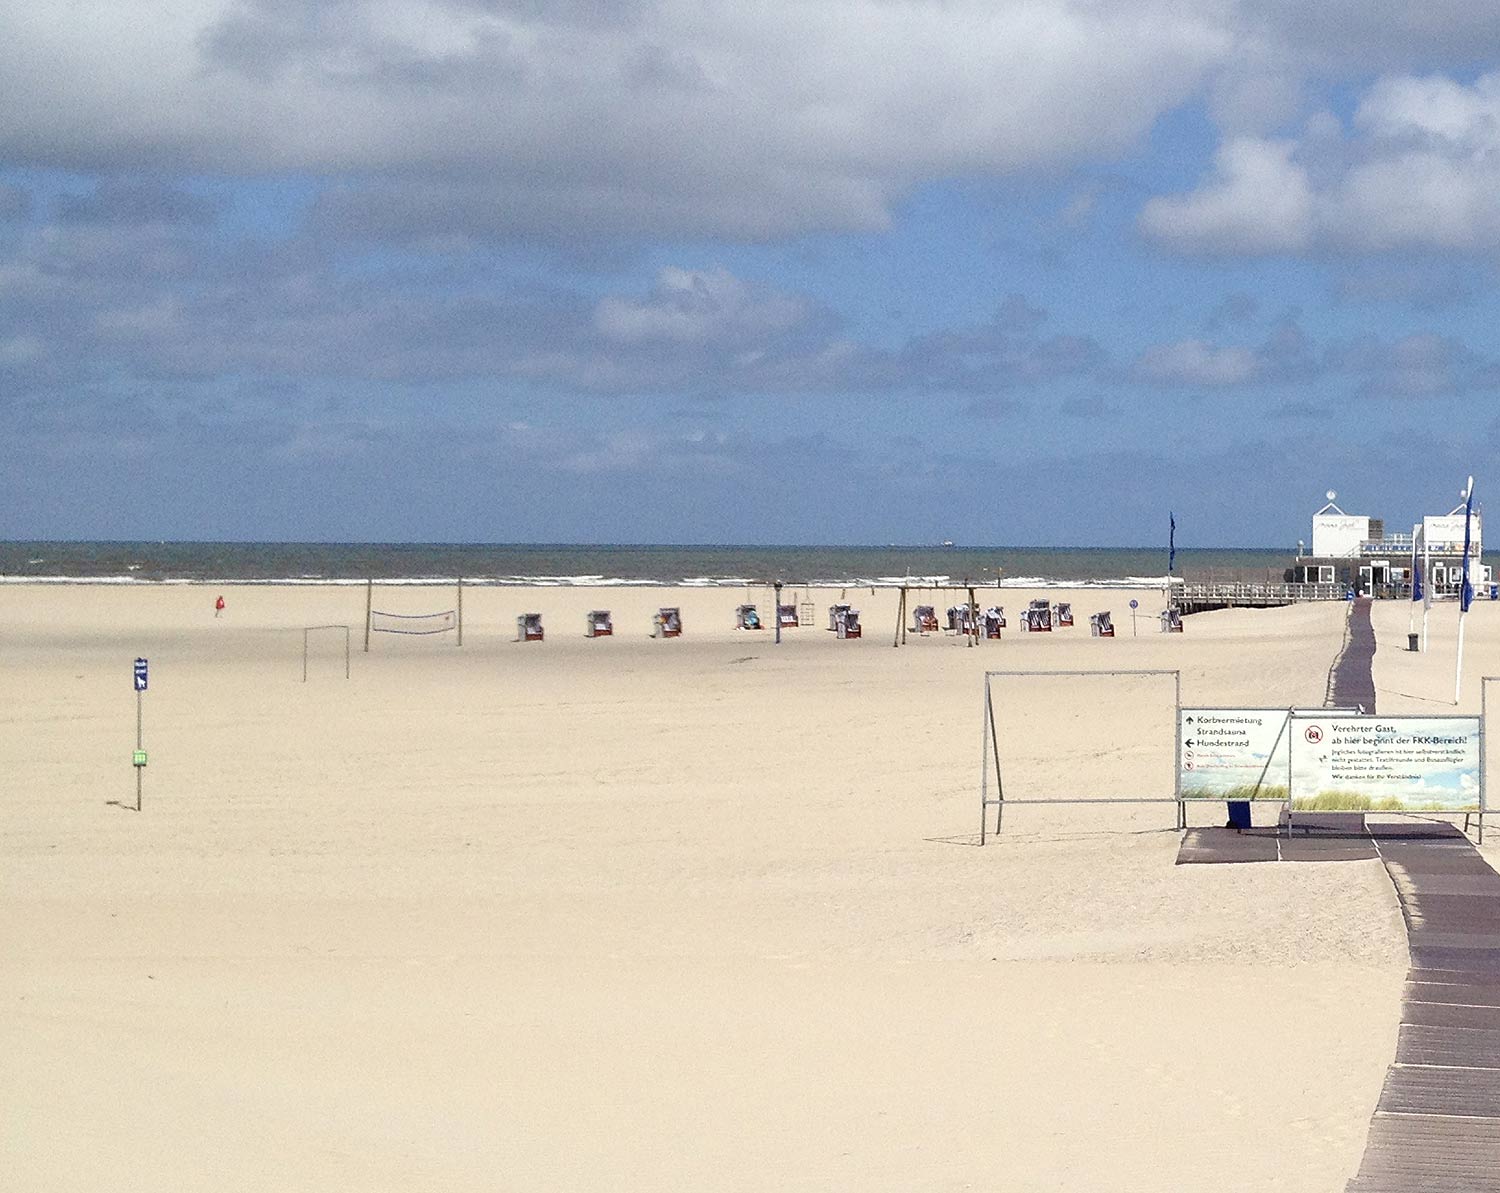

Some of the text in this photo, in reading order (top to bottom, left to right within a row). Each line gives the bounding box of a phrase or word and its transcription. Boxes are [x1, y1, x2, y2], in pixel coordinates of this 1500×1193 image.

[1196, 715, 1263, 726] Korbvermietung
[1196, 727, 1247, 736] Strandsauna
[1331, 724, 1397, 734] Verehrter Gast,
[1196, 739, 1250, 747] Hundestrand
[1331, 736, 1467, 746] ab hier beginnt der FKK-Bereich!
